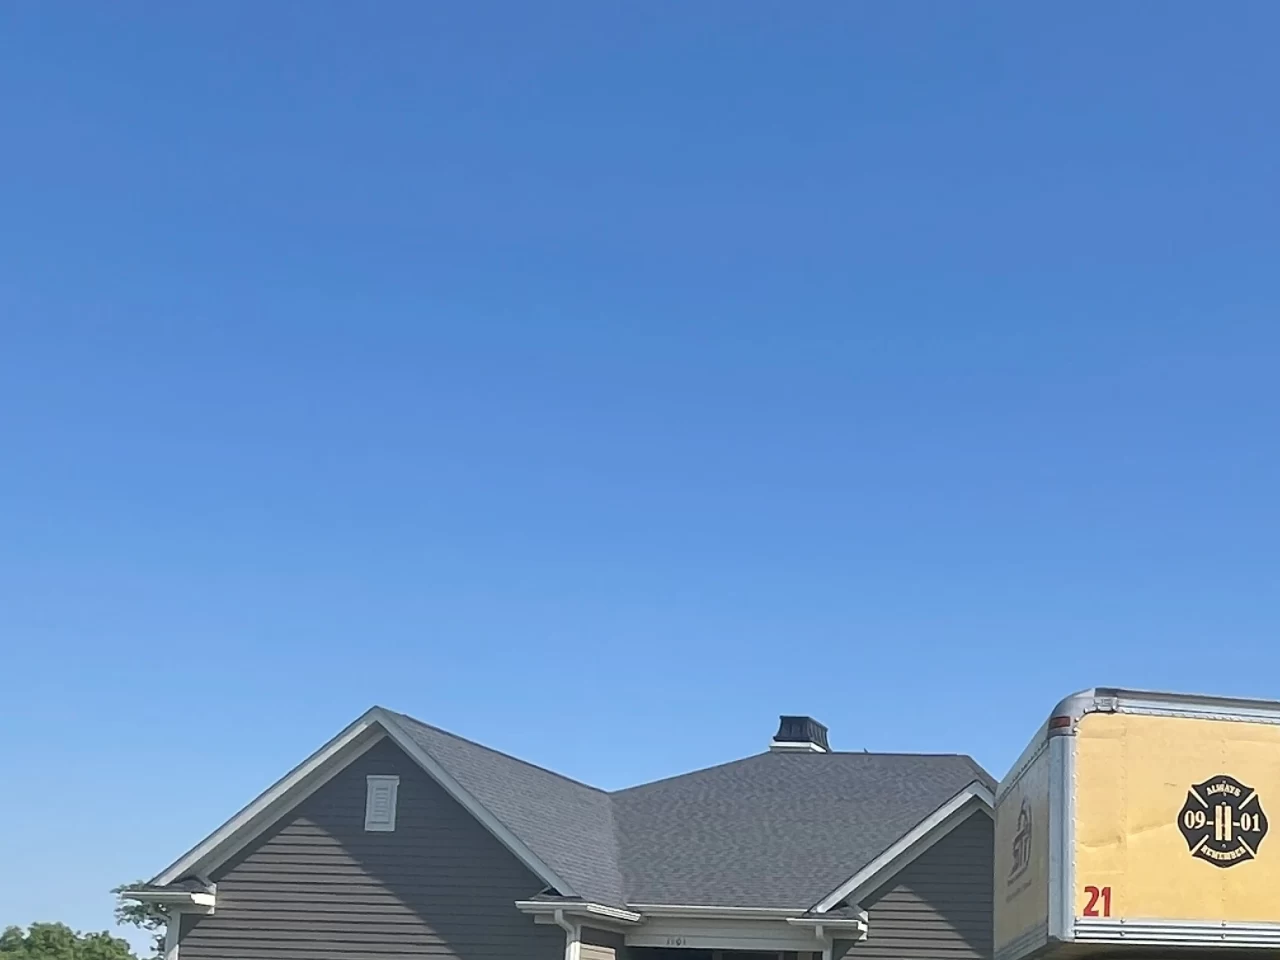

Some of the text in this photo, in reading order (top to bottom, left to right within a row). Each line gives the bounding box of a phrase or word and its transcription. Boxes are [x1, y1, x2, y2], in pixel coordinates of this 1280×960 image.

[1206, 783, 1241, 797] ALWAYS
[1200, 844, 1247, 860] REMEMBER
[1083, 886, 1111, 917] 21
